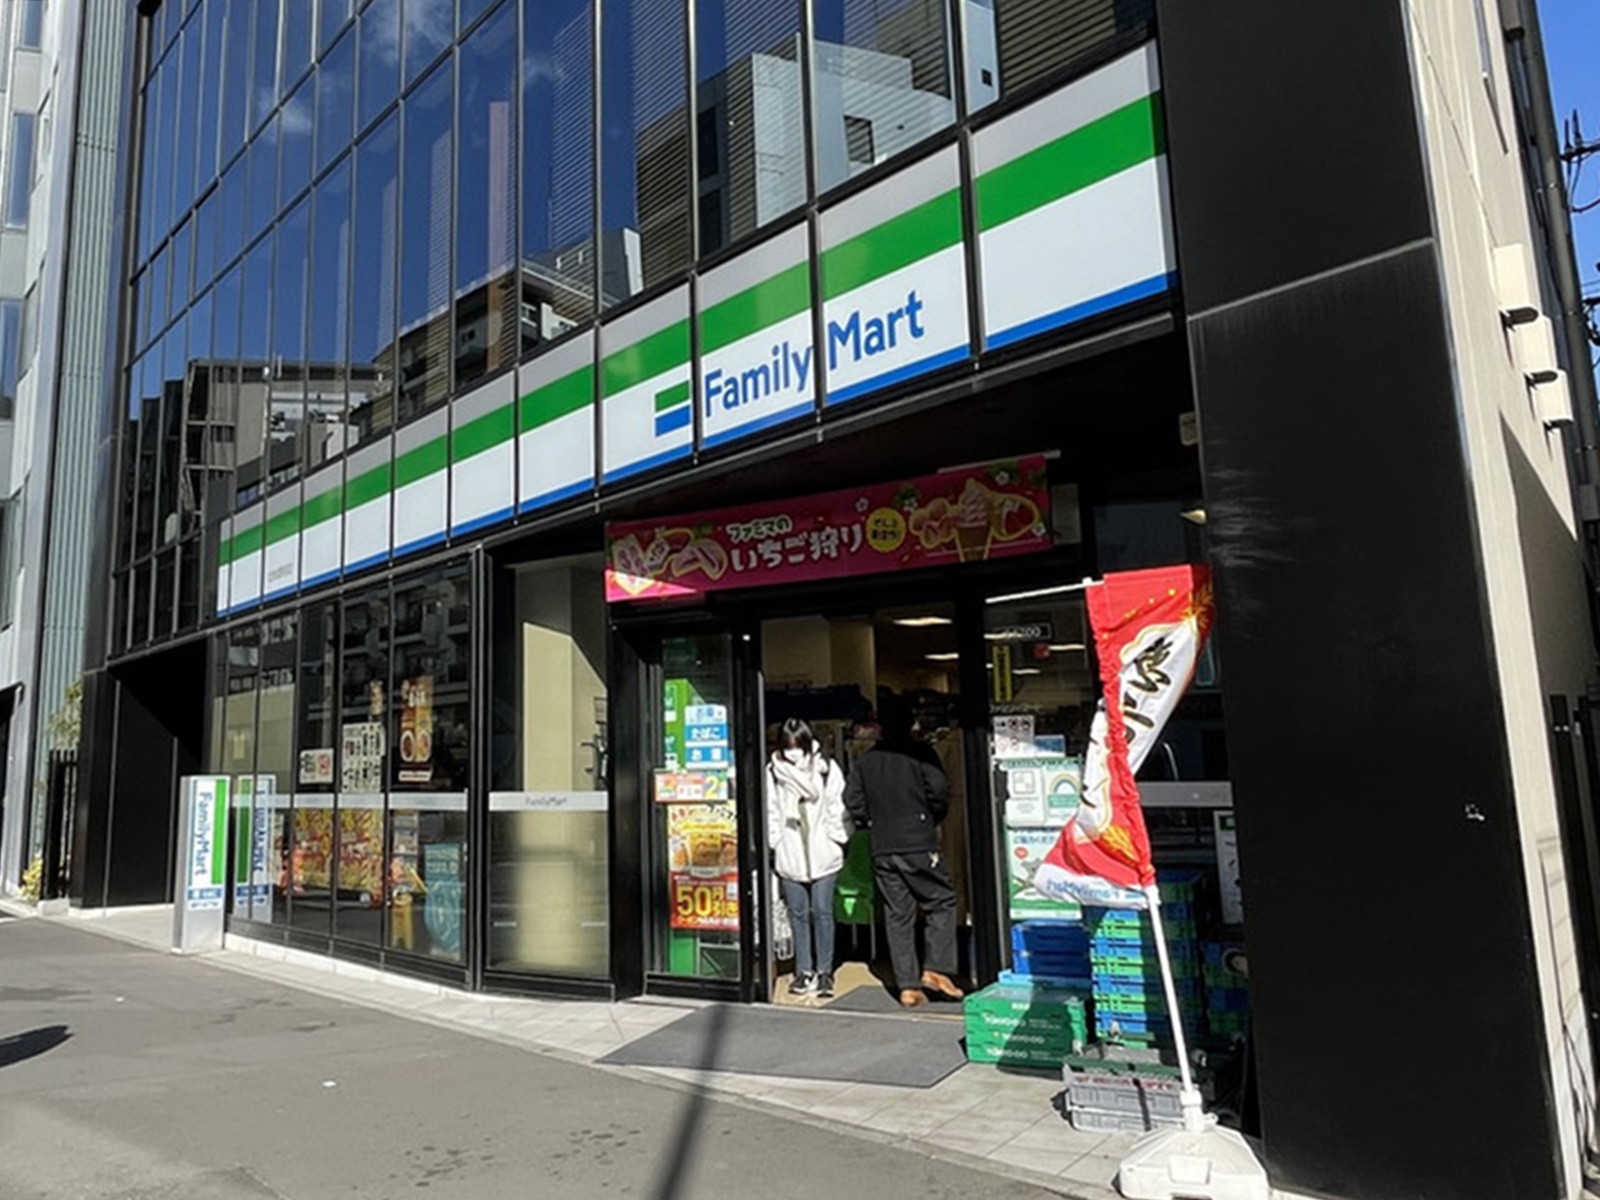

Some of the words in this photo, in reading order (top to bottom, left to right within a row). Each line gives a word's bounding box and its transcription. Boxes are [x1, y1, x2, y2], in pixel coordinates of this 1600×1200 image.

[727, 515, 792, 543] ファミマの
[731, 522, 863, 572] いちご狩り
[193, 791, 213, 876] FamilyMart
